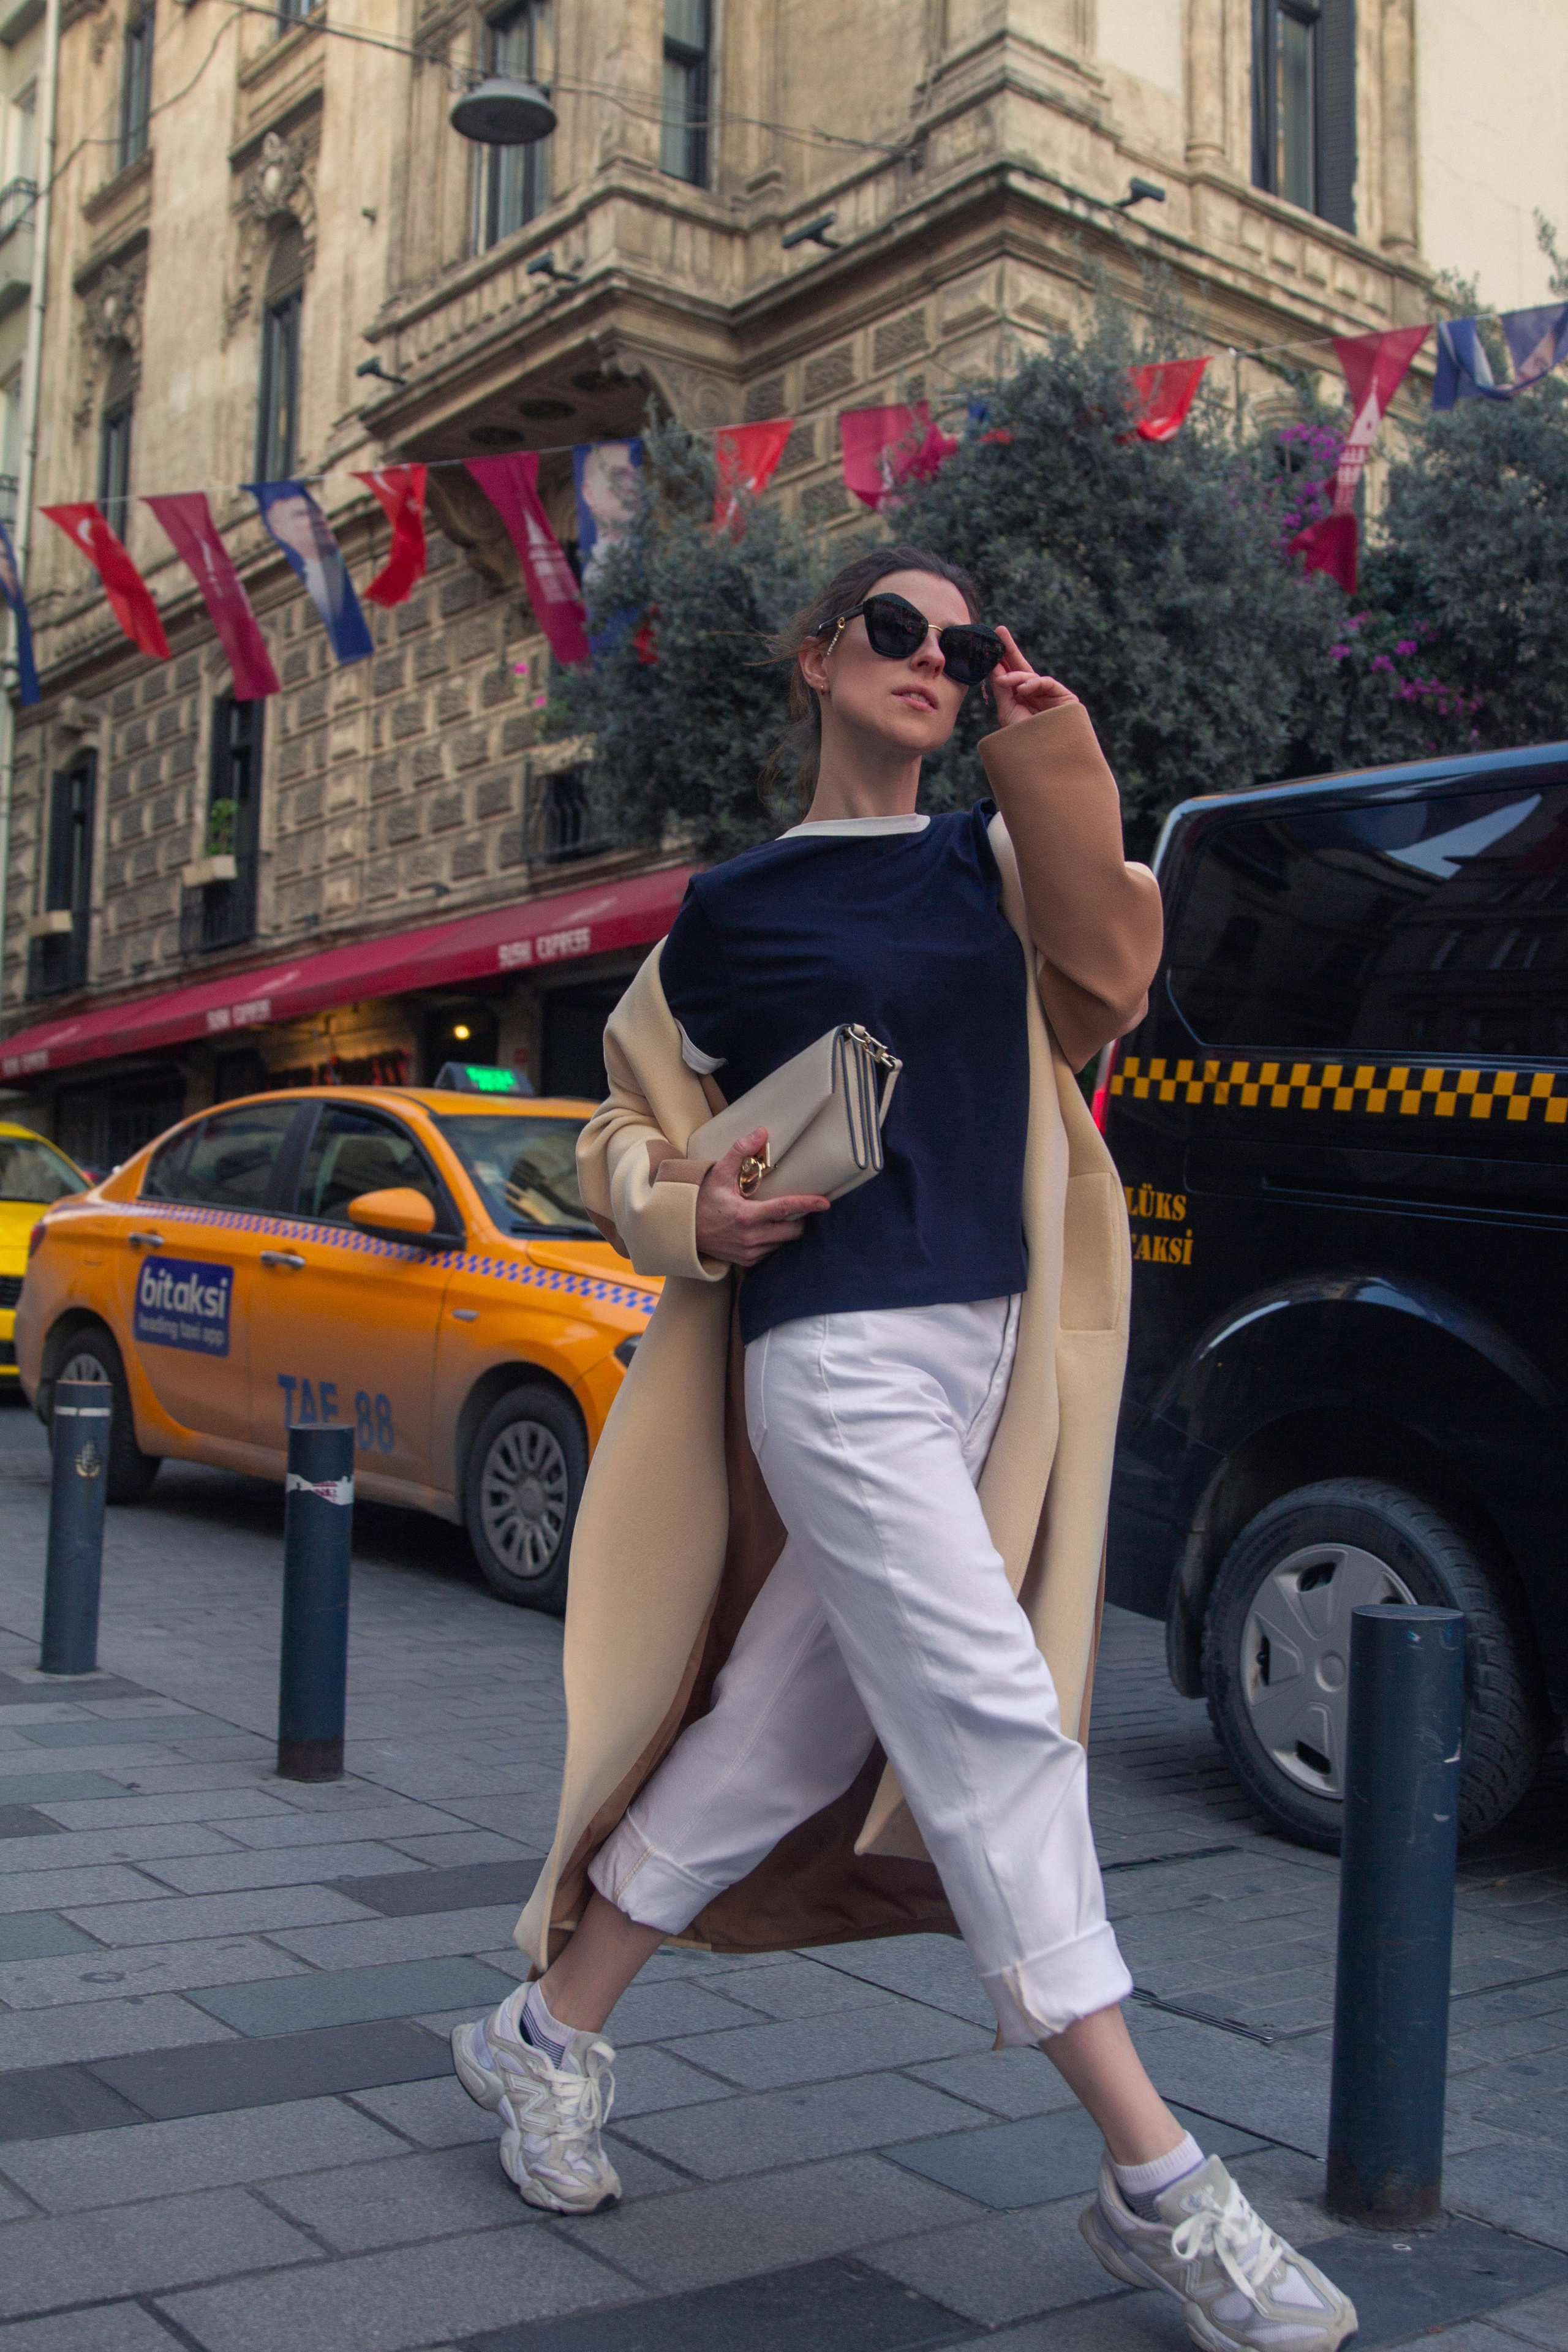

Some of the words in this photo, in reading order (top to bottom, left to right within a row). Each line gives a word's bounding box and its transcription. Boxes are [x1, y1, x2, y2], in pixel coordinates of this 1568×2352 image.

[1124, 1183, 1188, 1222] LÜKS
[140, 1265, 229, 1319] bitaksi
[355, 1389, 395, 1455] 88
